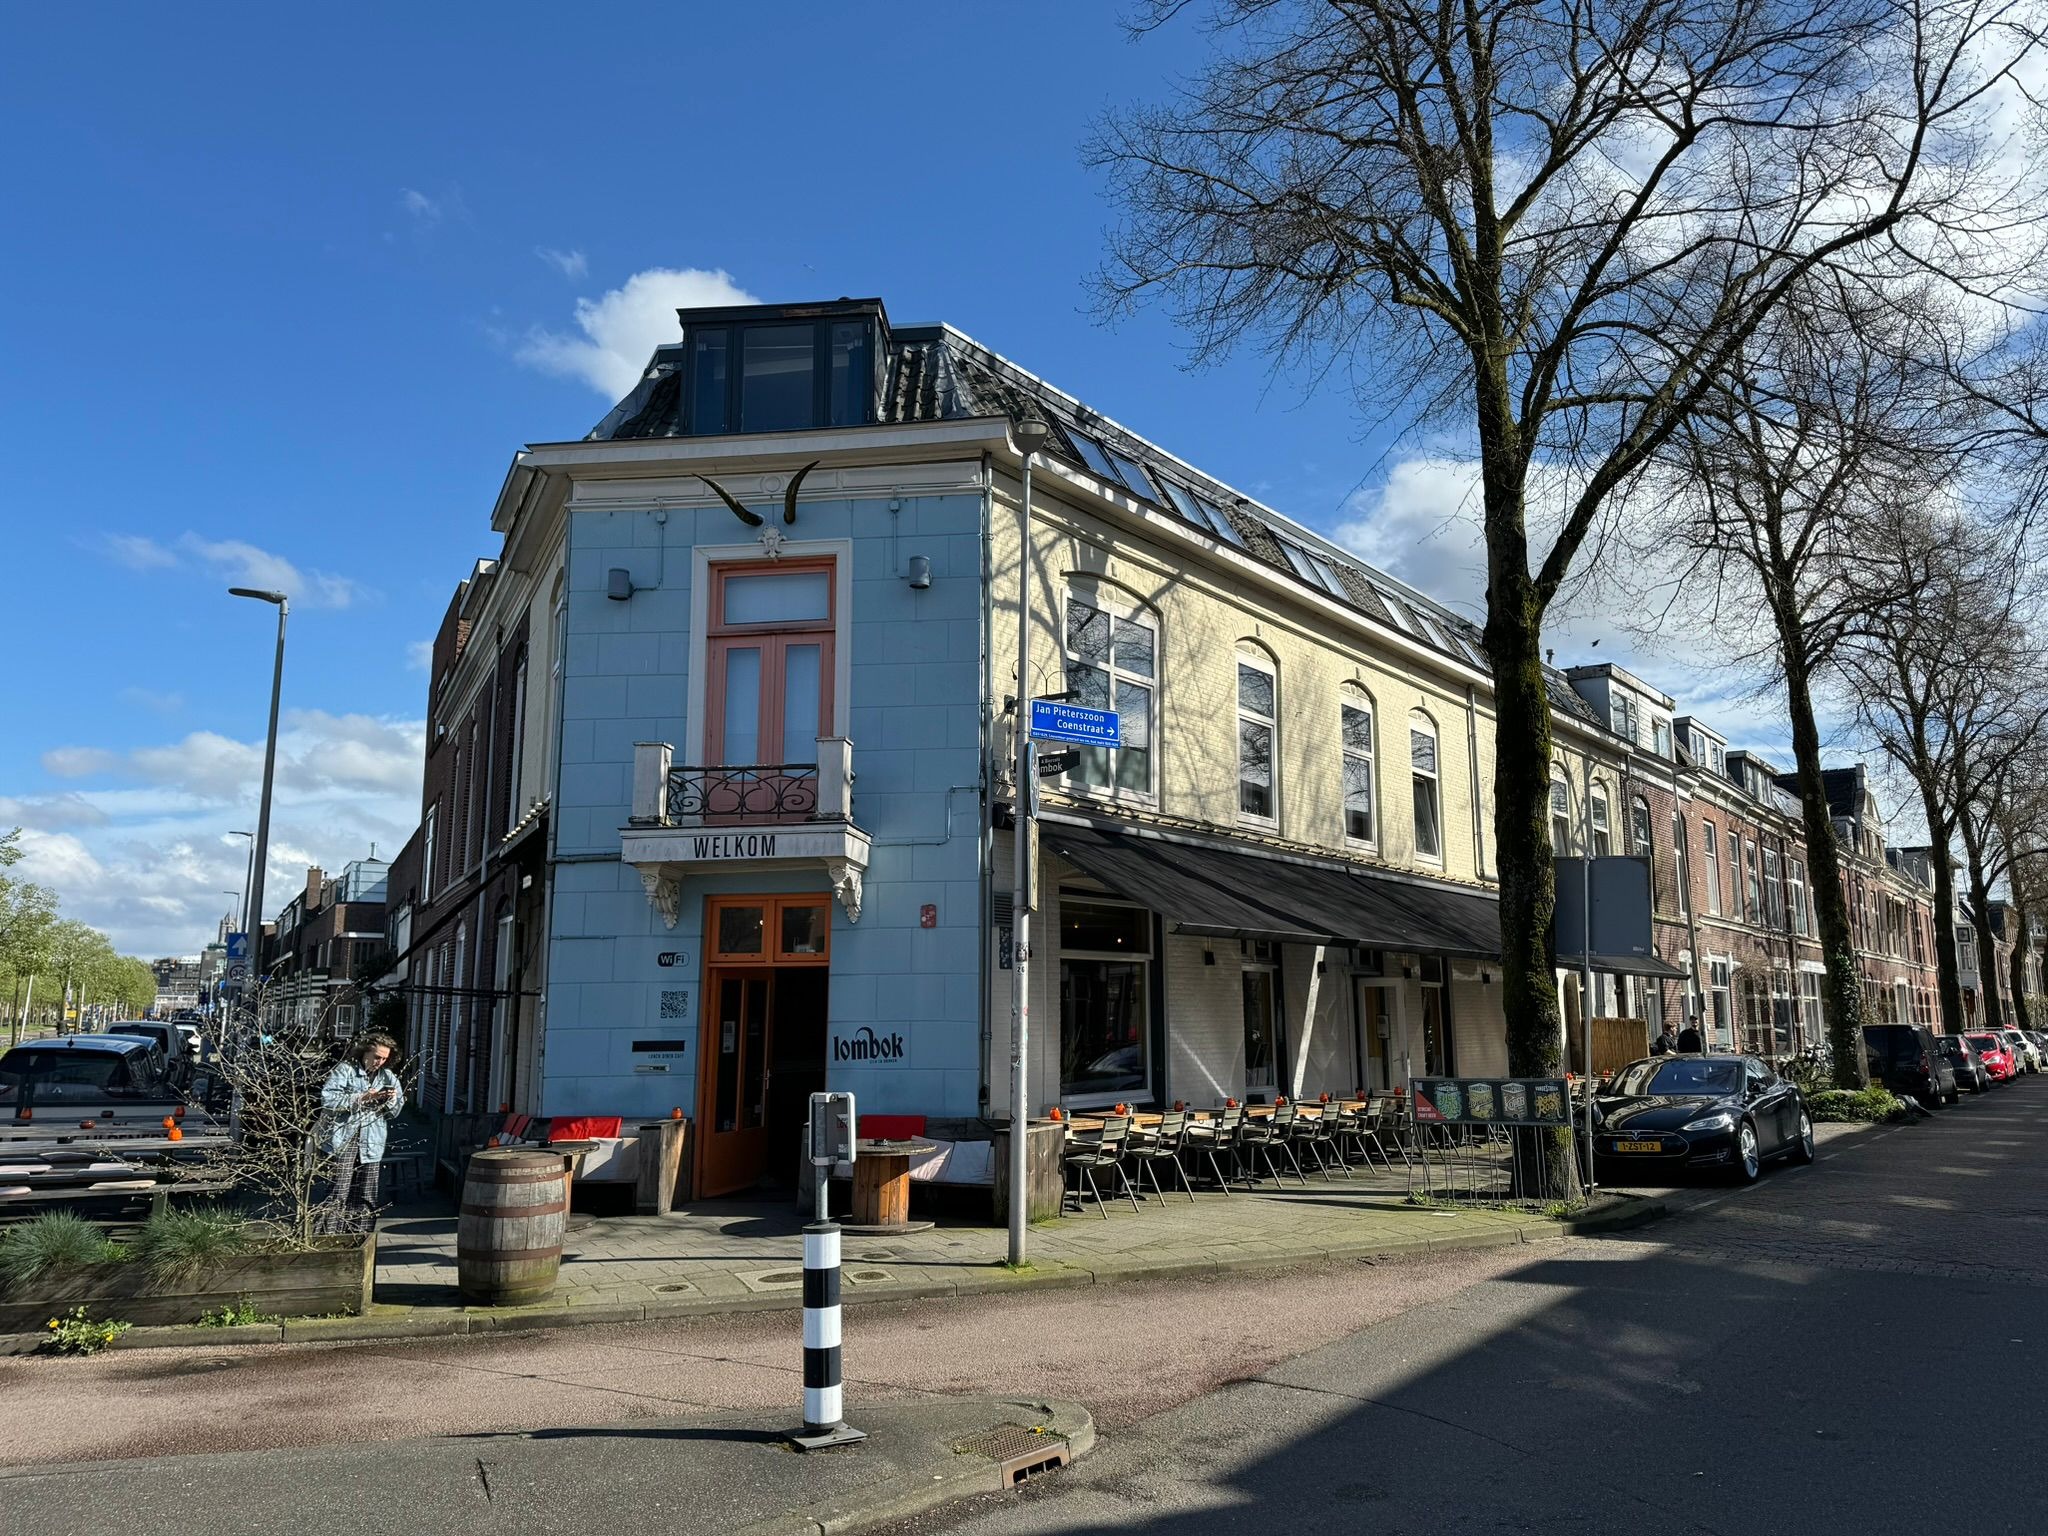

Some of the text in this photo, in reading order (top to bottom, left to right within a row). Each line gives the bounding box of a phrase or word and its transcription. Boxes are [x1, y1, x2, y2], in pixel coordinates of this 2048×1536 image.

[1036, 704, 1105, 722] Jan Pieterszoon
[1057, 719, 1104, 734] Coenstraat
[1040, 762, 1063, 773] mbok
[694, 835, 776, 859] WELKOM
[660, 954, 685, 965] WiFi
[833, 1026, 904, 1061] lombok
